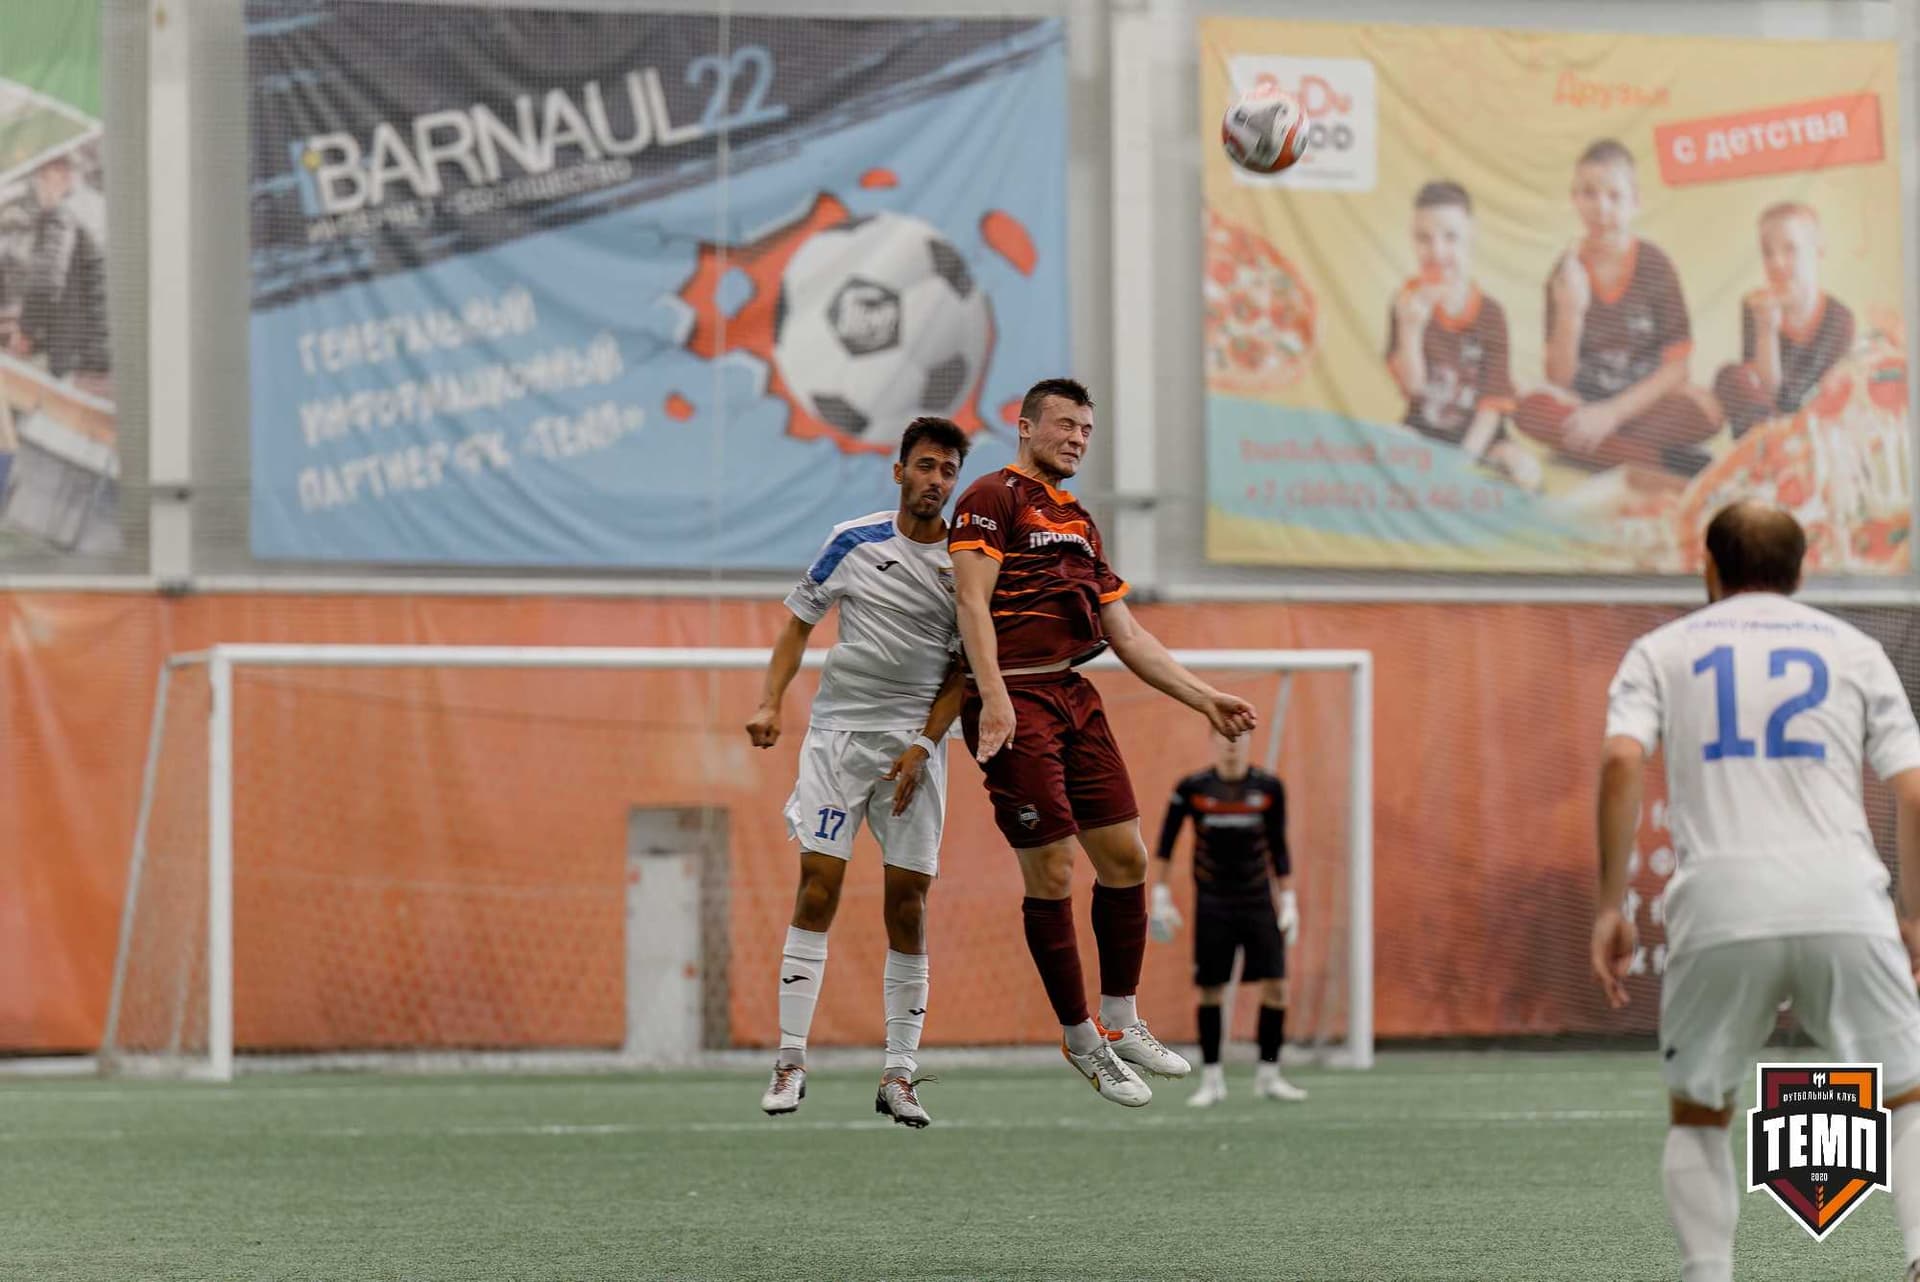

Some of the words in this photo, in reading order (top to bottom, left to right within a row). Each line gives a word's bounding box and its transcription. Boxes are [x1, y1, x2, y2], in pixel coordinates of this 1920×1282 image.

[1704, 110, 1849, 165] детства
[971, 513, 998, 531] ПСБ
[1693, 645, 1829, 761] 12
[815, 807, 847, 841] 17
